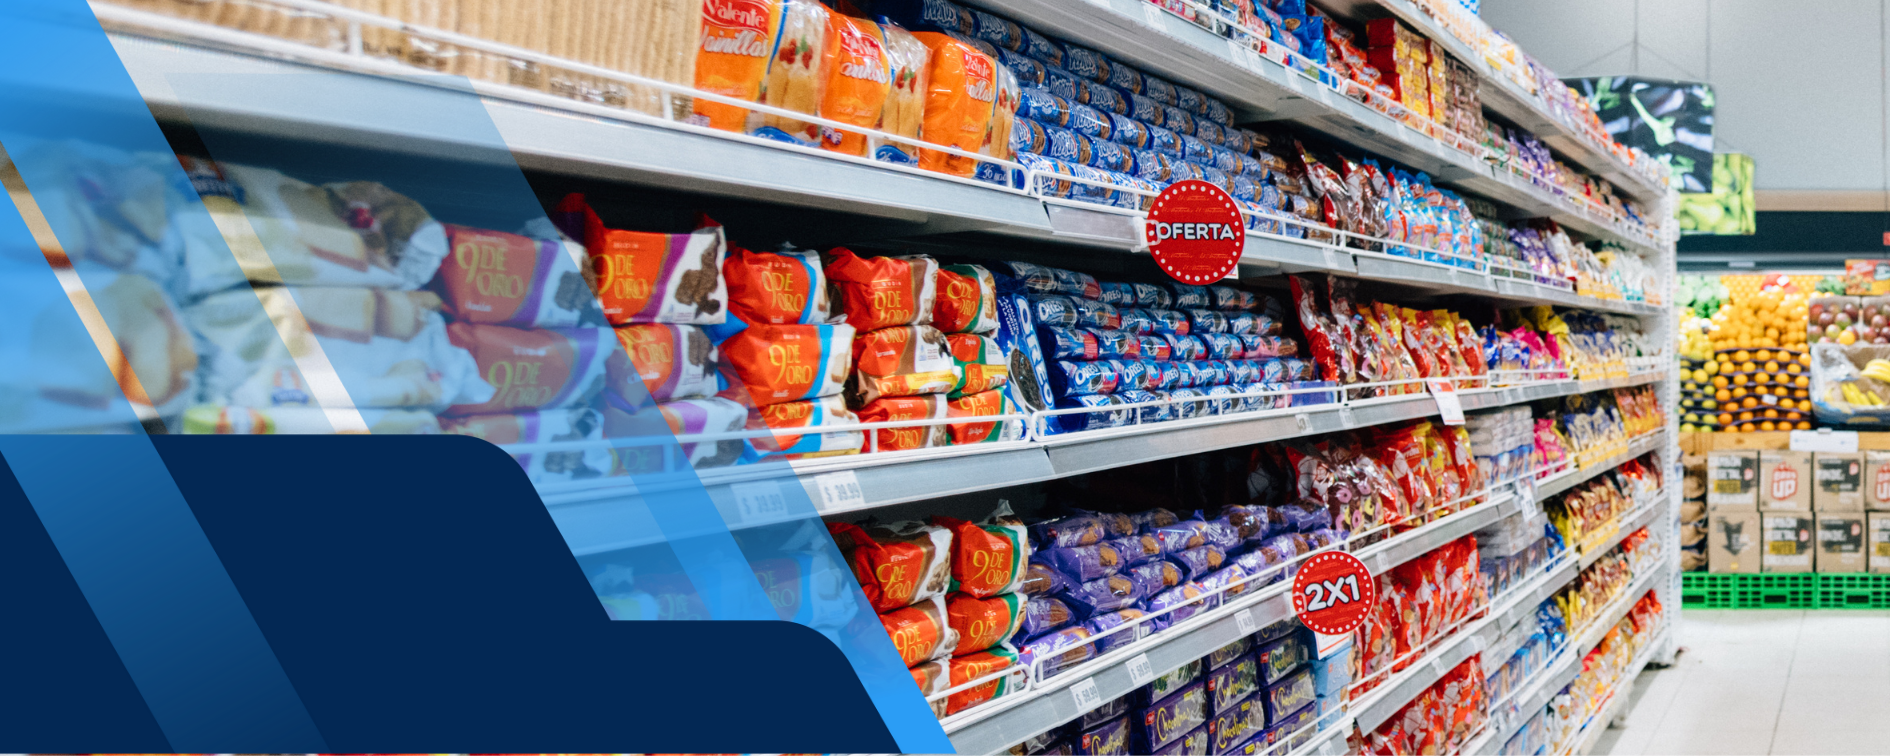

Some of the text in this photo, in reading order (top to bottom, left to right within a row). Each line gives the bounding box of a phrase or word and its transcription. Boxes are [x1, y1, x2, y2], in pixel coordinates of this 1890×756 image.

[1155, 221, 1236, 241] OFERTA
[480, 245, 508, 271] DE
[615, 254, 636, 276] DE
[476, 272, 524, 299] ORO
[613, 278, 649, 300] ORO
[1014, 296, 1055, 407] OREO
[513, 361, 543, 385] DE
[769, 344, 801, 384] 9 DE
[786, 365, 813, 384] ORO
[1075, 364, 1099, 386] OREO
[1124, 361, 1145, 384] OREO
[899, 429, 919, 449] ORO
[1773, 479, 1796, 499] UP
[973, 549, 1005, 580] 9 DE
[986, 568, 1010, 586] ORO
[1304, 573, 1362, 613] 2X1
[970, 620, 984, 646] 9
[894, 629, 924, 660] 9 DE
[908, 642, 932, 662] ORO
[1130, 667, 1137, 682] $
[1075, 693, 1083, 708] $
